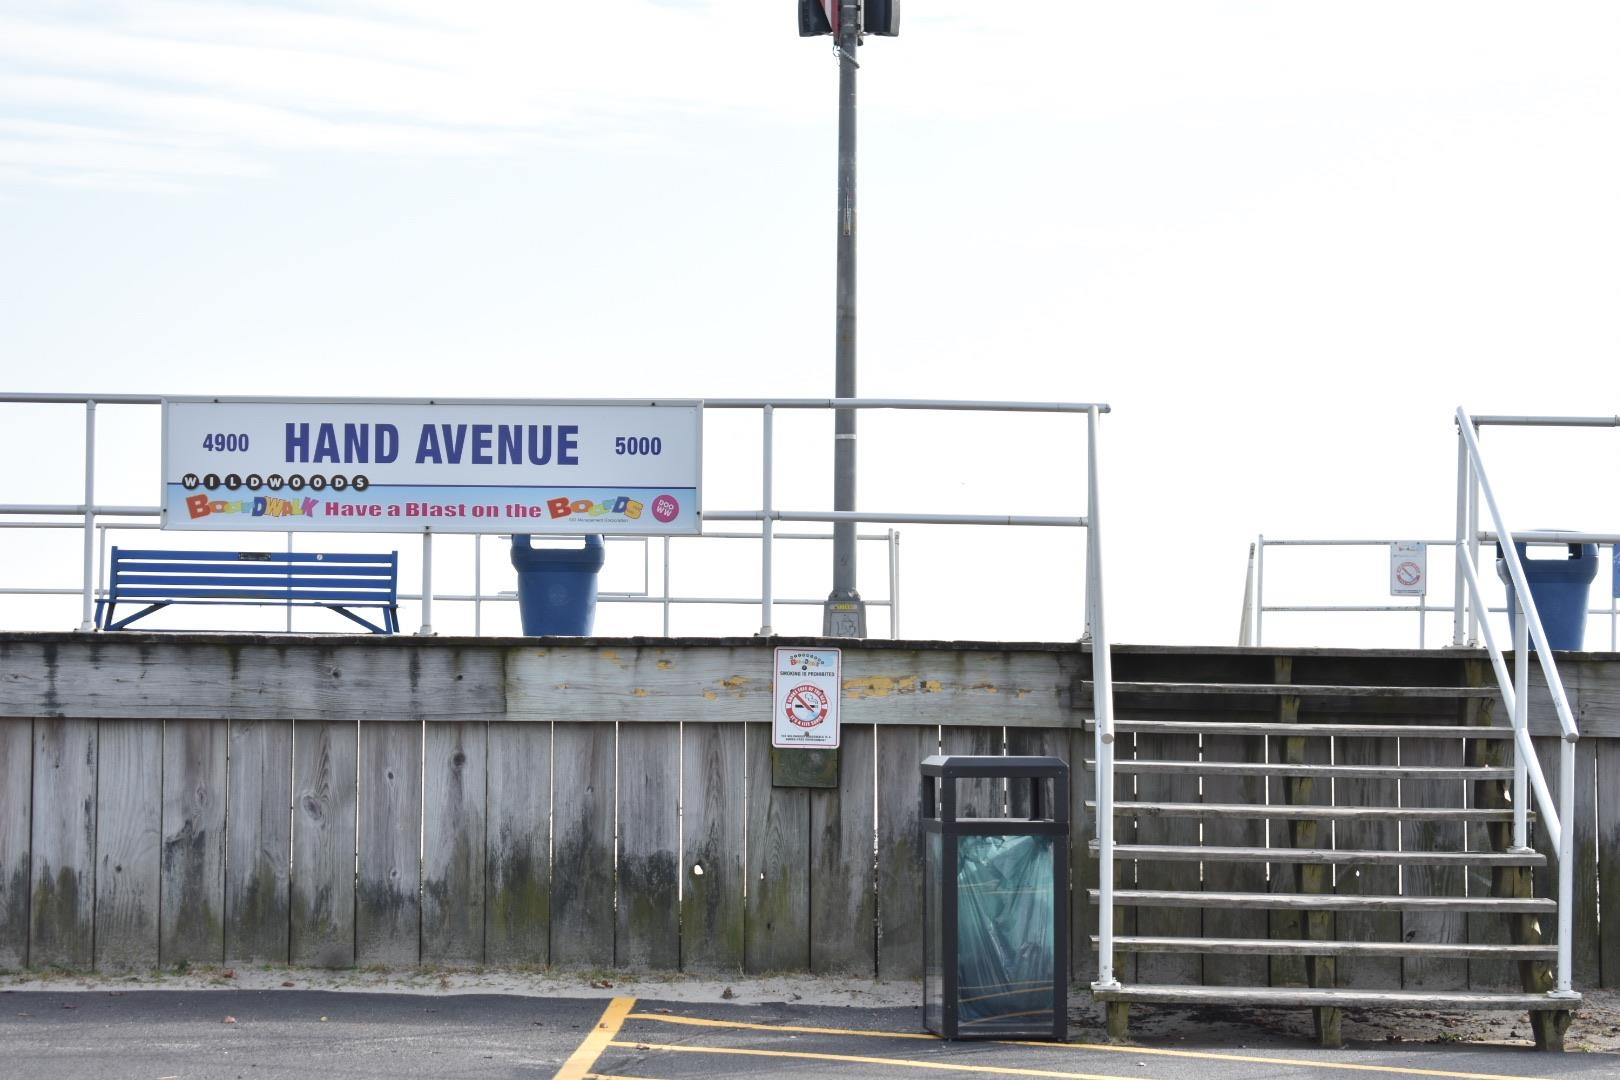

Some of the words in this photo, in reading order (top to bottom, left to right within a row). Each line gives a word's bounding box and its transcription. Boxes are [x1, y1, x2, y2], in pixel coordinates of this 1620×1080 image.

[202, 433, 250, 452] 4900
[285, 422, 399, 464] HAND
[415, 423, 579, 465] AVENUE
[614, 436, 662, 456] 5000
[183, 474, 368, 490] WILDWOODS
[325, 502, 383, 517] Have
[388, 505, 402, 517] a
[406, 502, 466, 517] Blast
[472, 505, 500, 517] on
[506, 504, 541, 518] the
